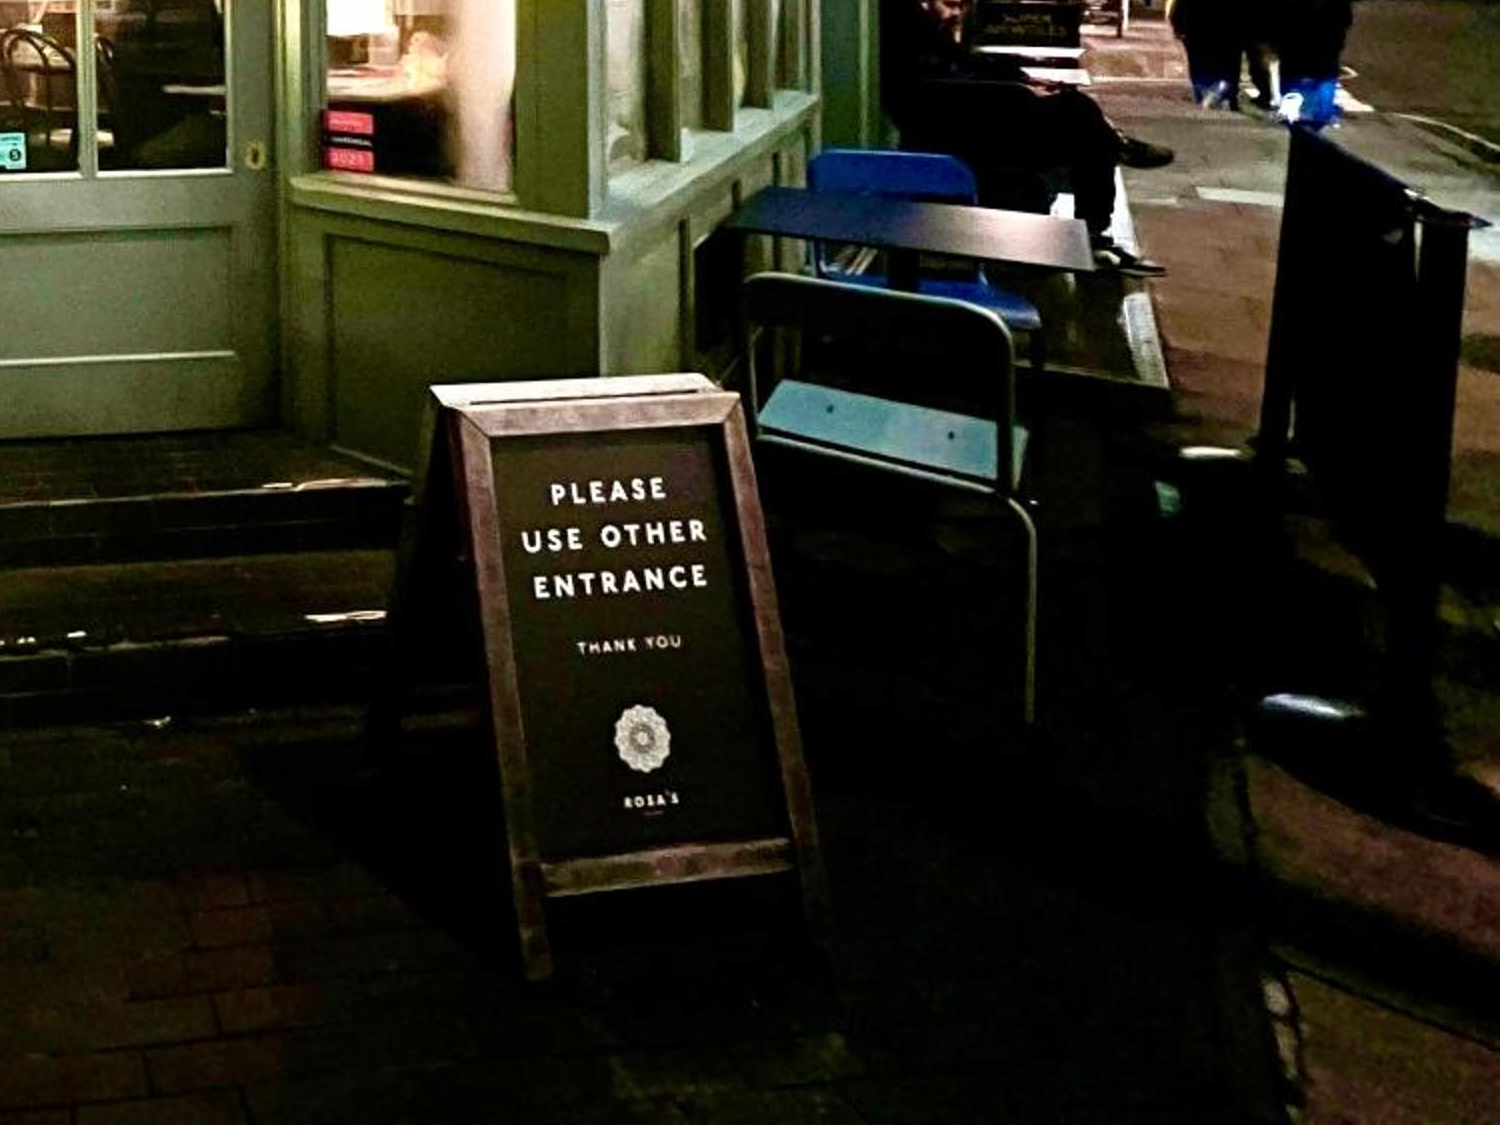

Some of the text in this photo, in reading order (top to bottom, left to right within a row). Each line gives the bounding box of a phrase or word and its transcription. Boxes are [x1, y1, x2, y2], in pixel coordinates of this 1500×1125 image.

[550, 477, 667, 506] PLEASE
[521, 519, 708, 553] USE OTHER
[533, 564, 708, 599] ENTRANCE
[576, 635, 682, 656] THANK YOU
[624, 790, 679, 808] ROSA'S
